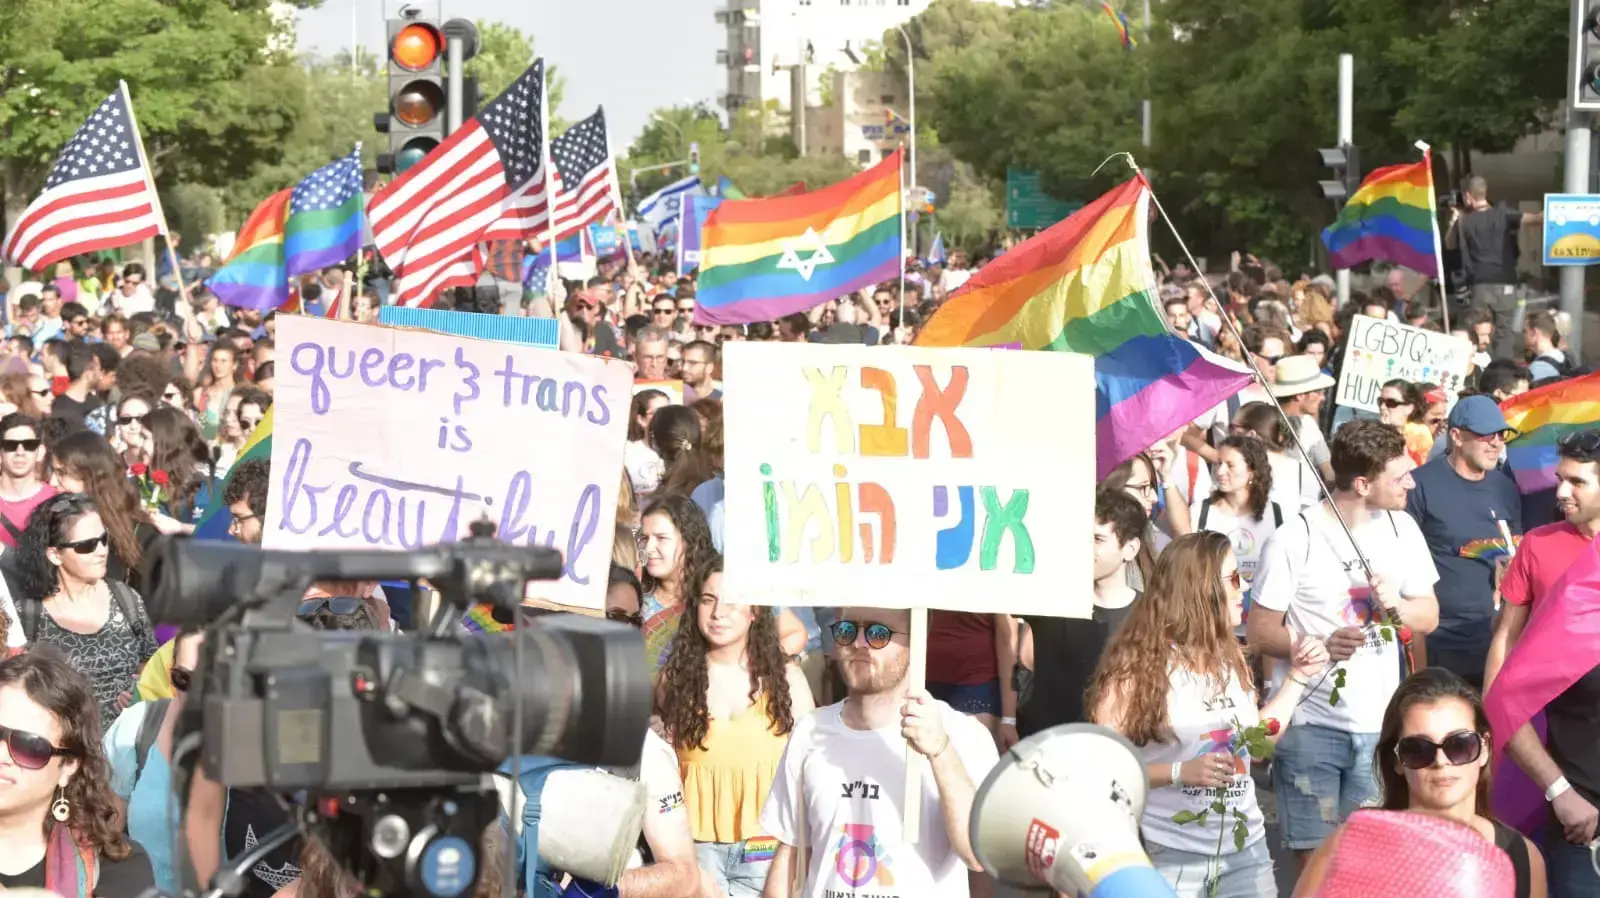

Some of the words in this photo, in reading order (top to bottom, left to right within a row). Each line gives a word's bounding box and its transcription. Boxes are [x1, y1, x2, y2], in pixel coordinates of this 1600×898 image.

[290, 342, 446, 415] queer
[493, 354, 611, 426] trans
[1352, 319, 1428, 363] LGBTQ
[438, 416, 473, 452] is
[801, 364, 974, 459] אבא
[279, 437, 600, 585] beautful
[932, 484, 1036, 575] אני
